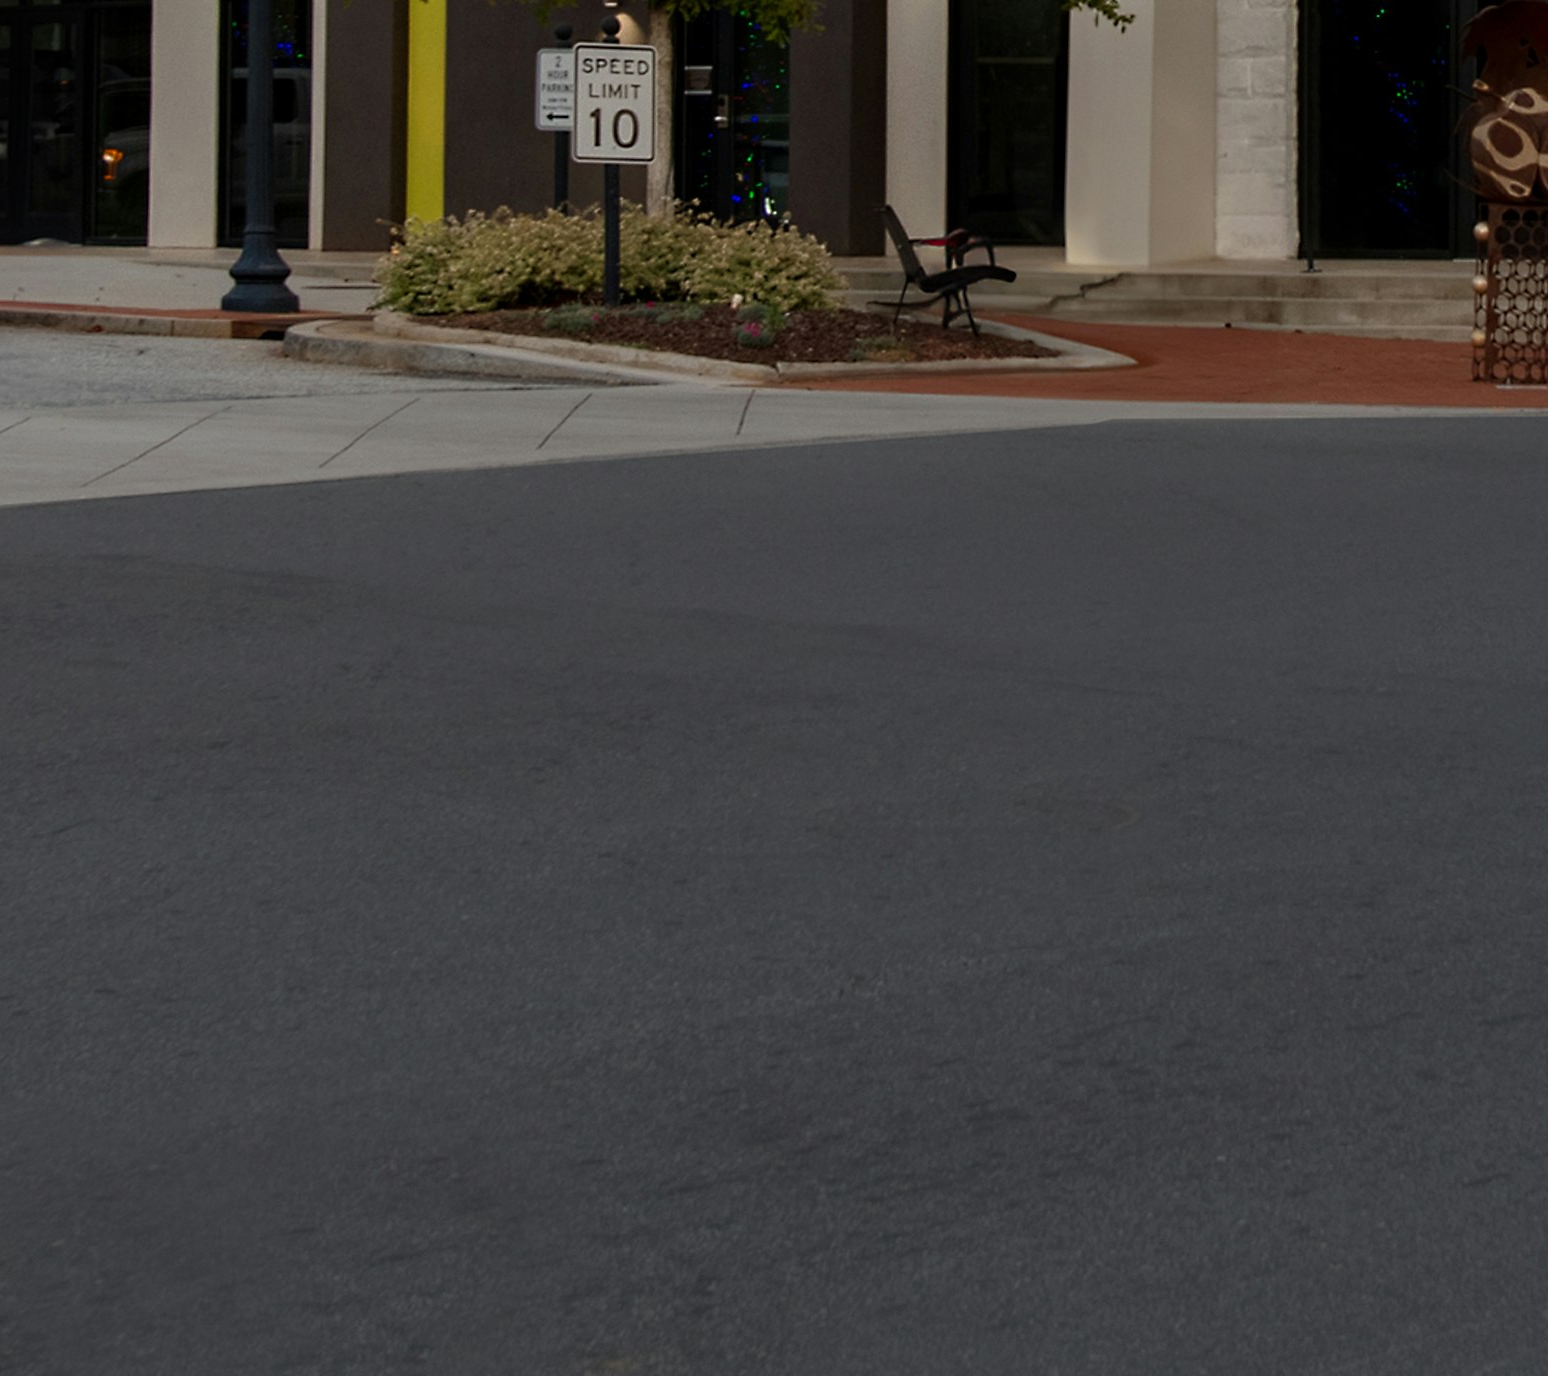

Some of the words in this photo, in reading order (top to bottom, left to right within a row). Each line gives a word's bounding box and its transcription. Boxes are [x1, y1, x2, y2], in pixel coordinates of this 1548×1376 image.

[581, 57, 650, 76] SPEED
[588, 83, 641, 100] LIMIT
[589, 107, 640, 149] 10
